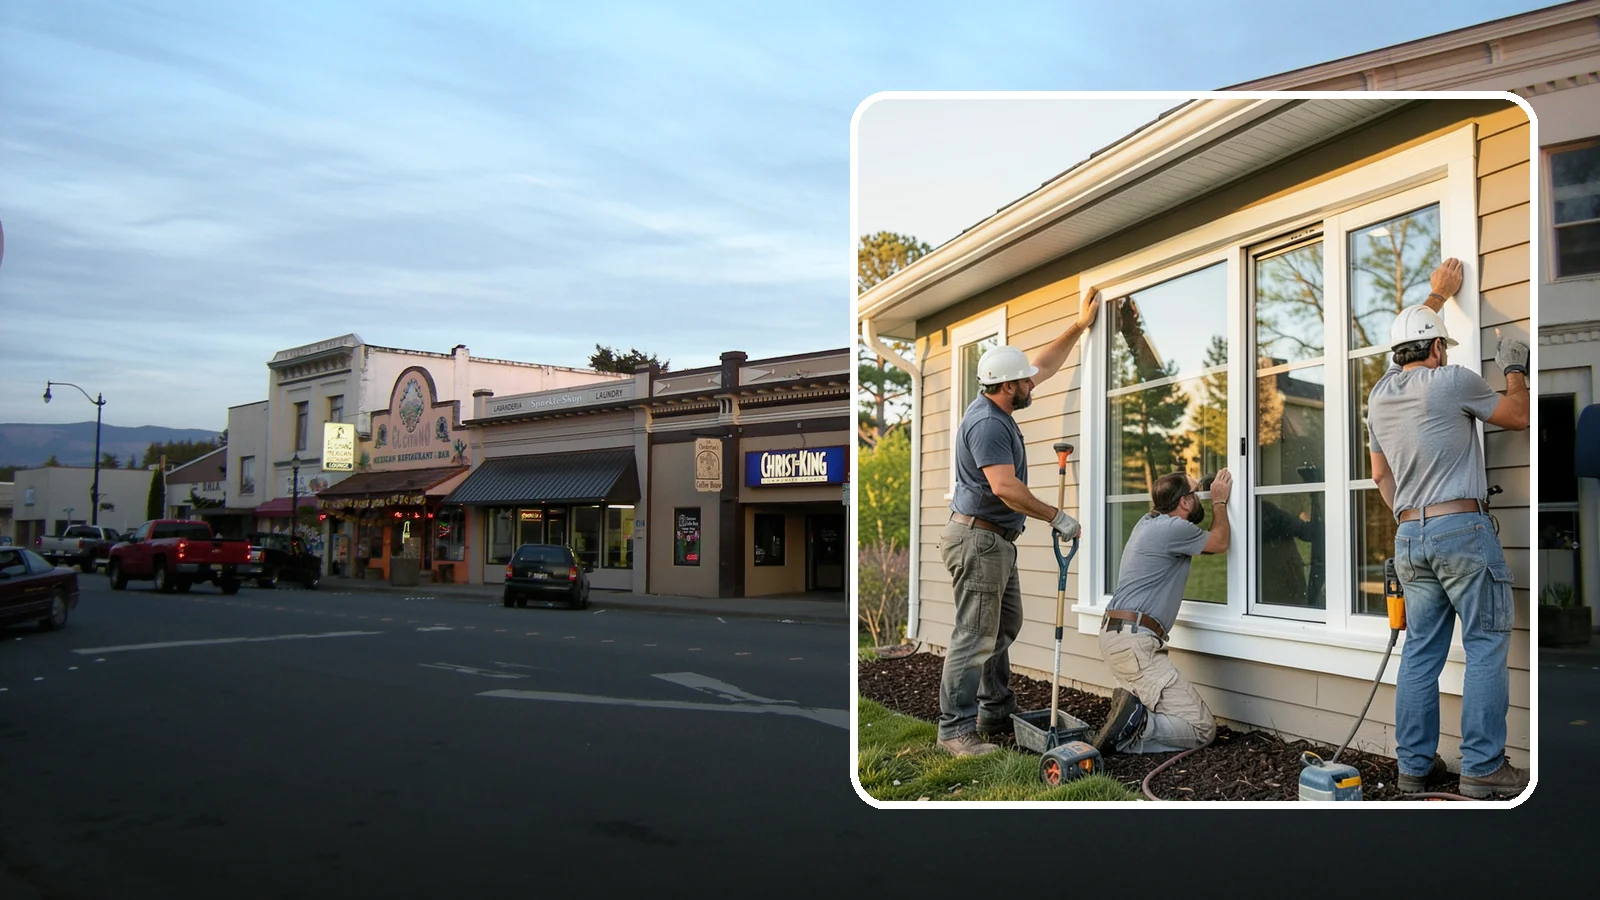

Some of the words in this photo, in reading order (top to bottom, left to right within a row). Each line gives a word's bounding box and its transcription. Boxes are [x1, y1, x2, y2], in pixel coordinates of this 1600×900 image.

[596, 389, 623, 400] LAUNDRY
[494, 402, 523, 412] LAVANDERIA
[531, 399, 560, 409] Sparkle
[562, 395, 582, 406] Shop
[374, 455, 396, 464] MEXICAN
[398, 452, 433, 462] RESTAURANT
[438, 450, 450, 459] BAR
[761, 452, 797, 477] CHRIST
[799, 450, 827, 476] KING
